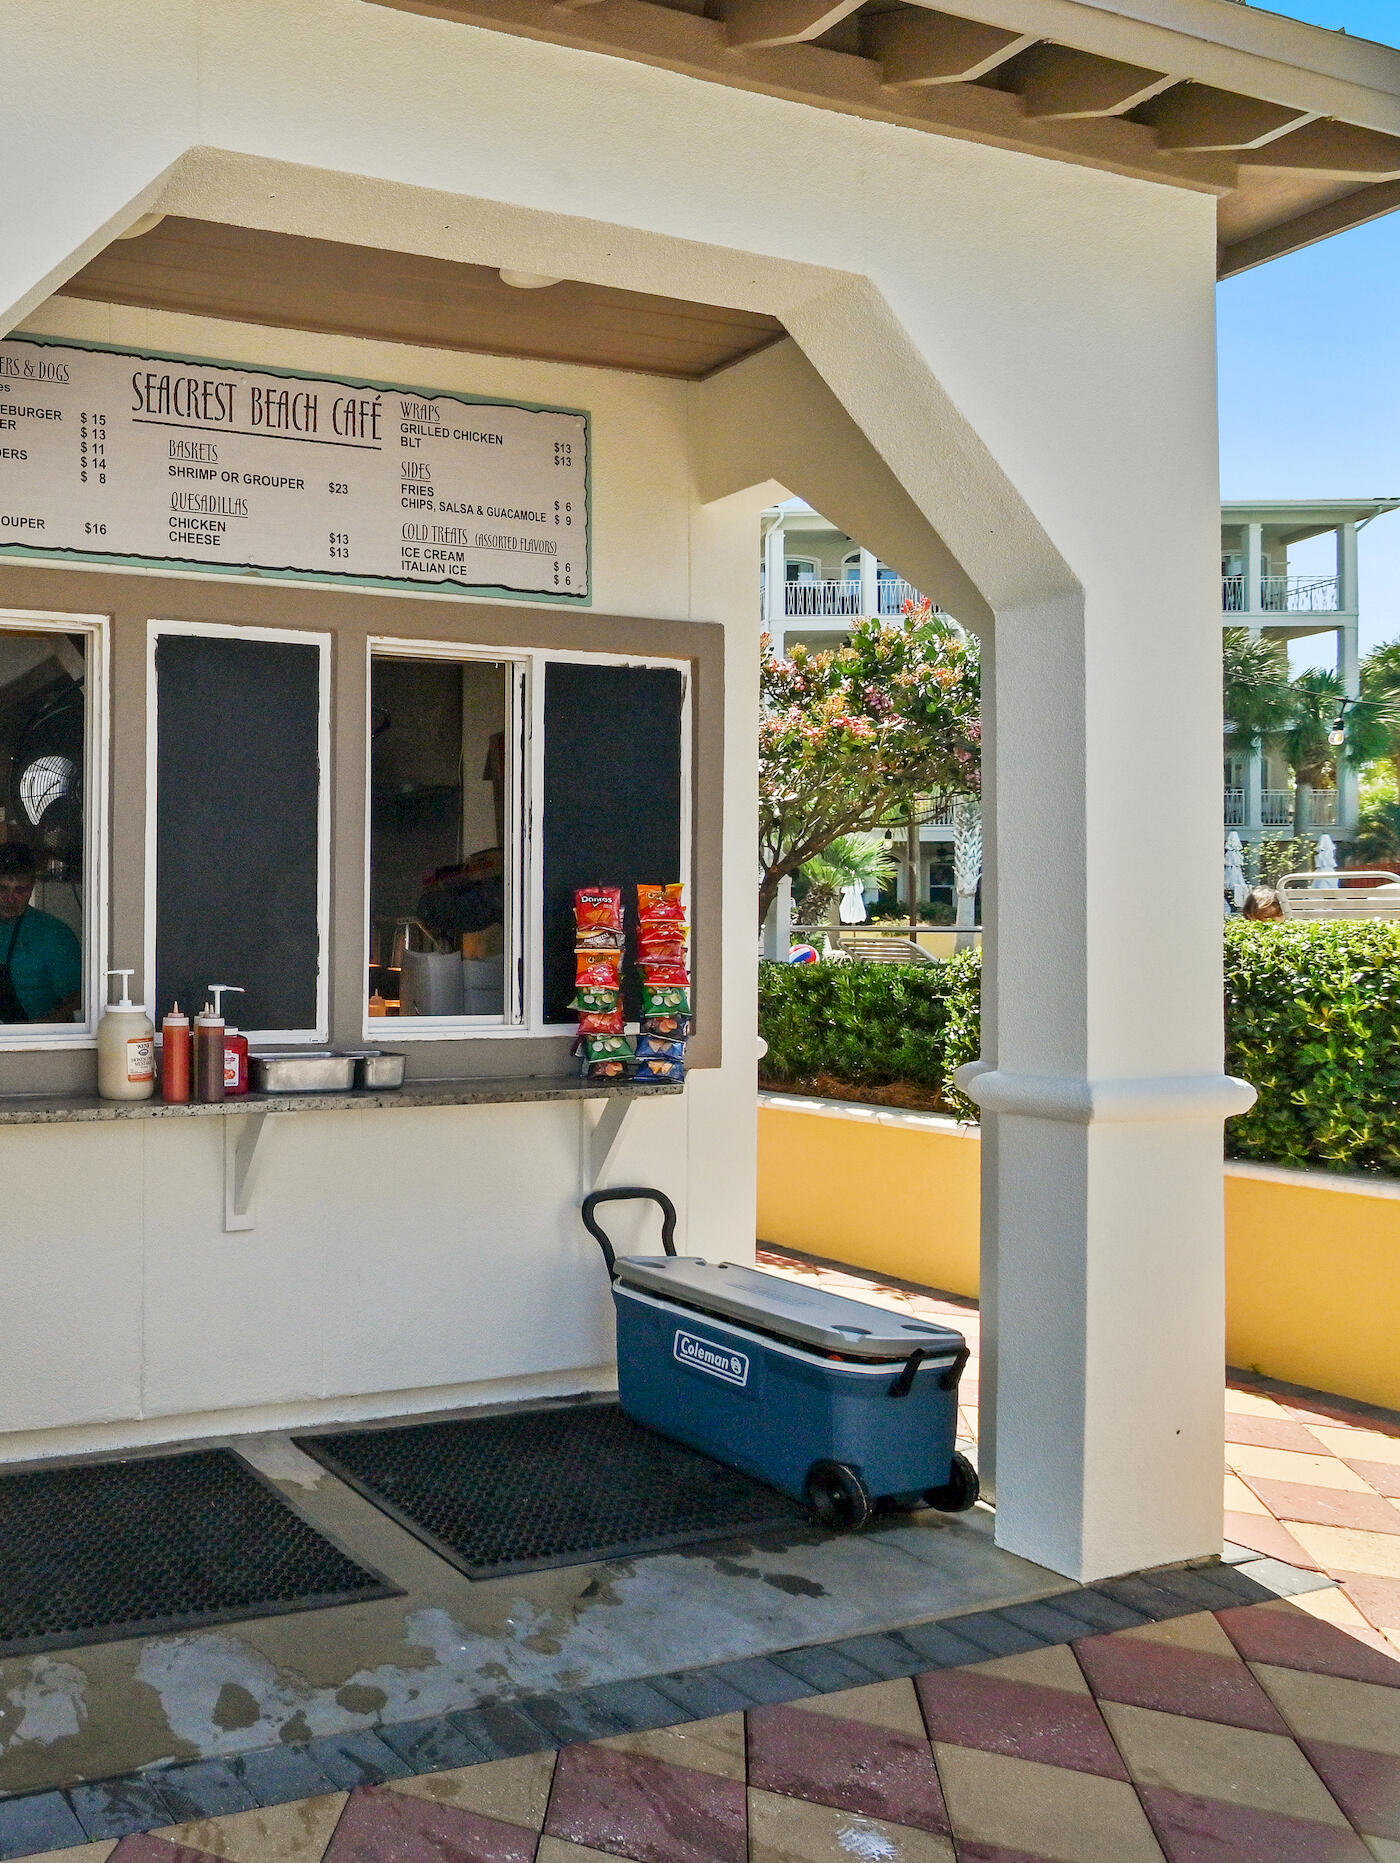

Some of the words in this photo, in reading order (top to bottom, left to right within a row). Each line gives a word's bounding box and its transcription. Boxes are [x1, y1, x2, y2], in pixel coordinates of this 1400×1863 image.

[24, 360, 37, 378] &
[40, 361, 70, 381] DOGS
[131, 371, 238, 423] SEACREST
[250, 386, 318, 433] BEACH
[332, 394, 383, 441] CAFÉ
[400, 401, 440, 422] WRAPS
[400, 422, 450, 439] GRILLED
[452, 429, 503, 446] CHICKEN
[553, 441, 572, 454] $13
[169, 440, 218, 462] BASKETS
[400, 435, 422, 449] BLT
[554, 455, 572, 467] $13
[168, 465, 218, 481] SHRIMP
[220, 470, 240, 484] OR
[242, 473, 305, 491] GROUPER
[328, 481, 349, 495] $23
[401, 461, 431, 480] SIDES
[401, 483, 435, 498] FRIES
[170, 492, 248, 517] QUESADILLAS
[400, 497, 436, 513] CHIPS,
[438, 501, 475, 515] SALSA
[476, 505, 484, 516] &
[486, 506, 547, 523] GUACAMOLE
[84, 521, 107, 536] $16
[168, 516, 226, 533] CHICKEN
[328, 532, 349, 545] $13
[402, 523, 430, 542] COLD
[431, 525, 468, 545] TREATS
[475, 533, 518, 552] (ASSORTED
[520, 537, 557, 556] FLAVORS)
[168, 530, 221, 546] CHEESE
[329, 546, 350, 559] $13
[401, 546, 421, 559] ICE
[423, 548, 465, 563] CREAM
[401, 559, 446, 574] ITALIAN
[448, 564, 468, 576] ICE
[581, 896, 612, 906] Doritos
[681, 1337, 729, 1370] Coleman
